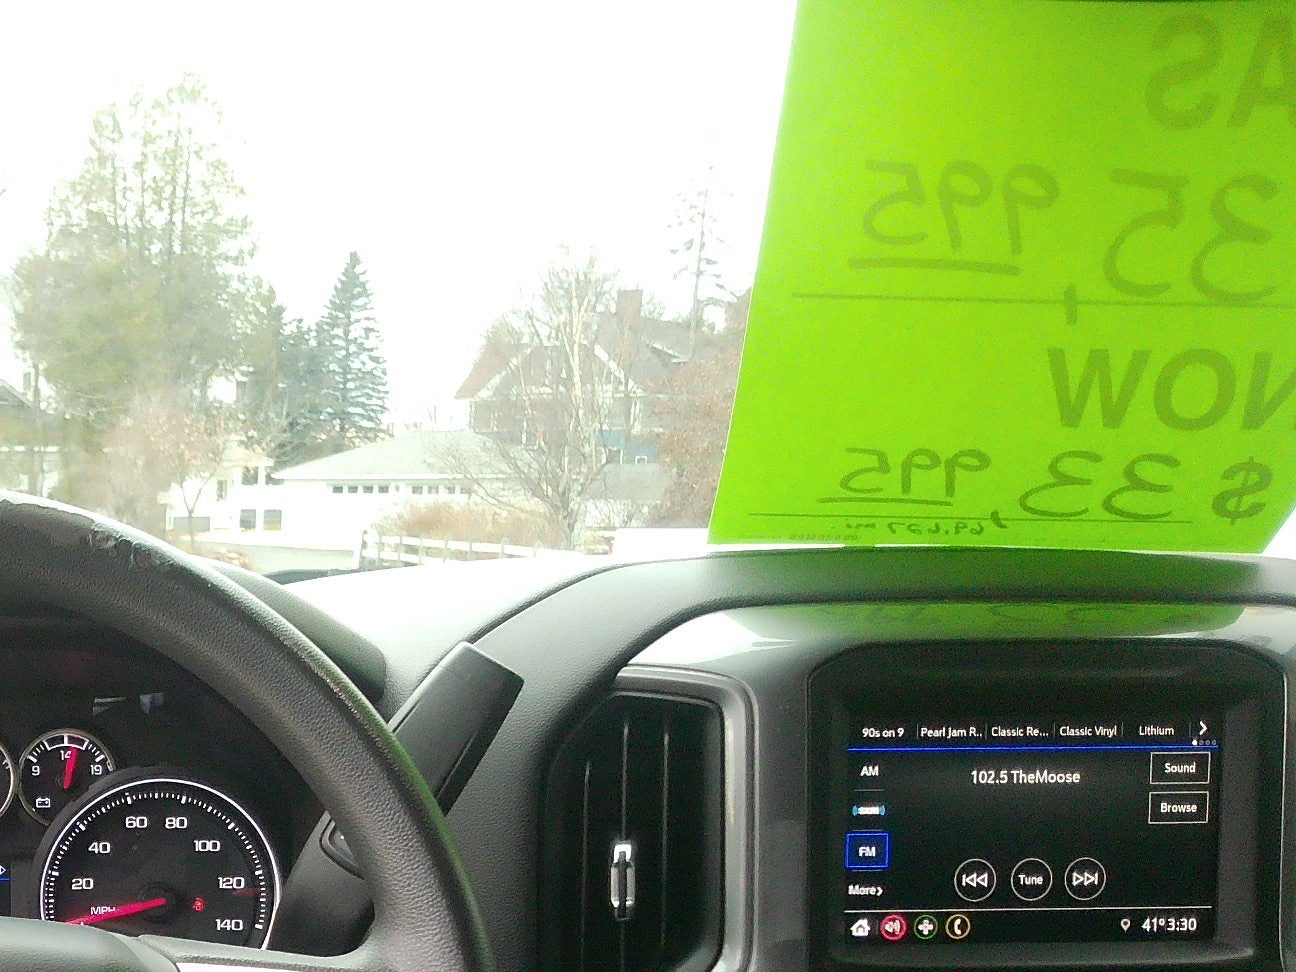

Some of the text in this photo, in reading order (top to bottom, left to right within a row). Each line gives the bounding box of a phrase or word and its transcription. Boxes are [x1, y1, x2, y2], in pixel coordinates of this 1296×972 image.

[862, 727, 905, 738] 90s on 9
[920, 727, 945, 738] Pearl
[947, 727, 966, 739] Jam
[991, 726, 1023, 738] Classic
[1059, 725, 1117, 738] Classic Vinyl
[1139, 725, 1174, 736] Lithium
[31, 766, 41, 777] 9
[90, 765, 103, 776] 19
[860, 765, 879, 777] AM
[1164, 762, 1196, 774] Sound
[971, 769, 1081, 784] 102.5 TheMoose
[1160, 802, 1198, 814] Browse
[125, 816, 148, 829] 60
[164, 816, 188, 829] 80
[88, 841, 111, 854] 40
[193, 840, 221, 852] 100
[858, 846, 876, 857] FM
[71, 877, 94, 890] 20
[217, 877, 245, 889] 120
[1018, 874, 1043, 885] Tune
[848, 884, 877, 895] More
[216, 919, 244, 931] 140
[1166, 917, 1197, 932] 3:30
